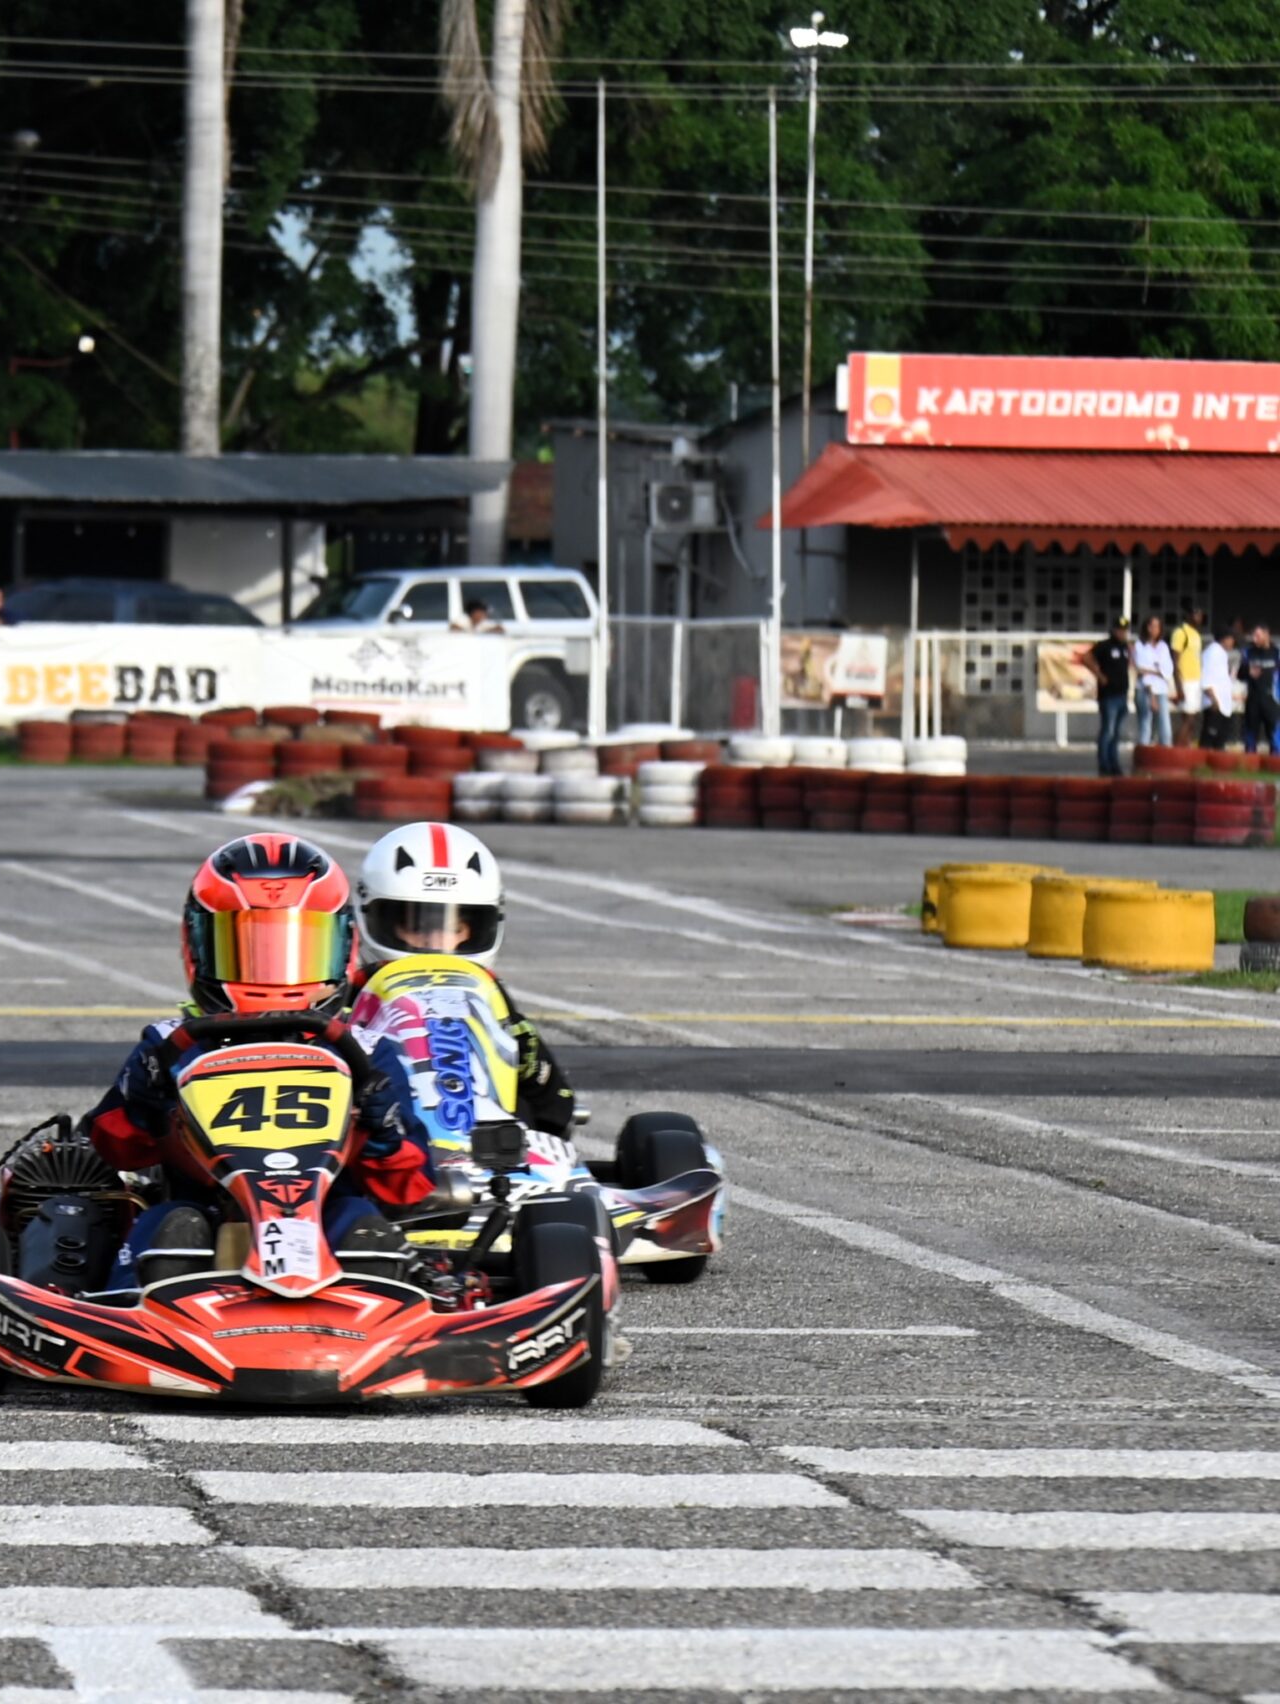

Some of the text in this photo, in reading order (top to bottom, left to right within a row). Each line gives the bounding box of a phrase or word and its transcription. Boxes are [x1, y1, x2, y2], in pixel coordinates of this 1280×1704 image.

[917, 387, 1180, 419] KARTODROMO
[312, 677, 467, 698] MondoKart
[422, 875, 458, 888] OMP
[425, 1017, 474, 1134] SONIC
[209, 1085, 332, 1133] 45
